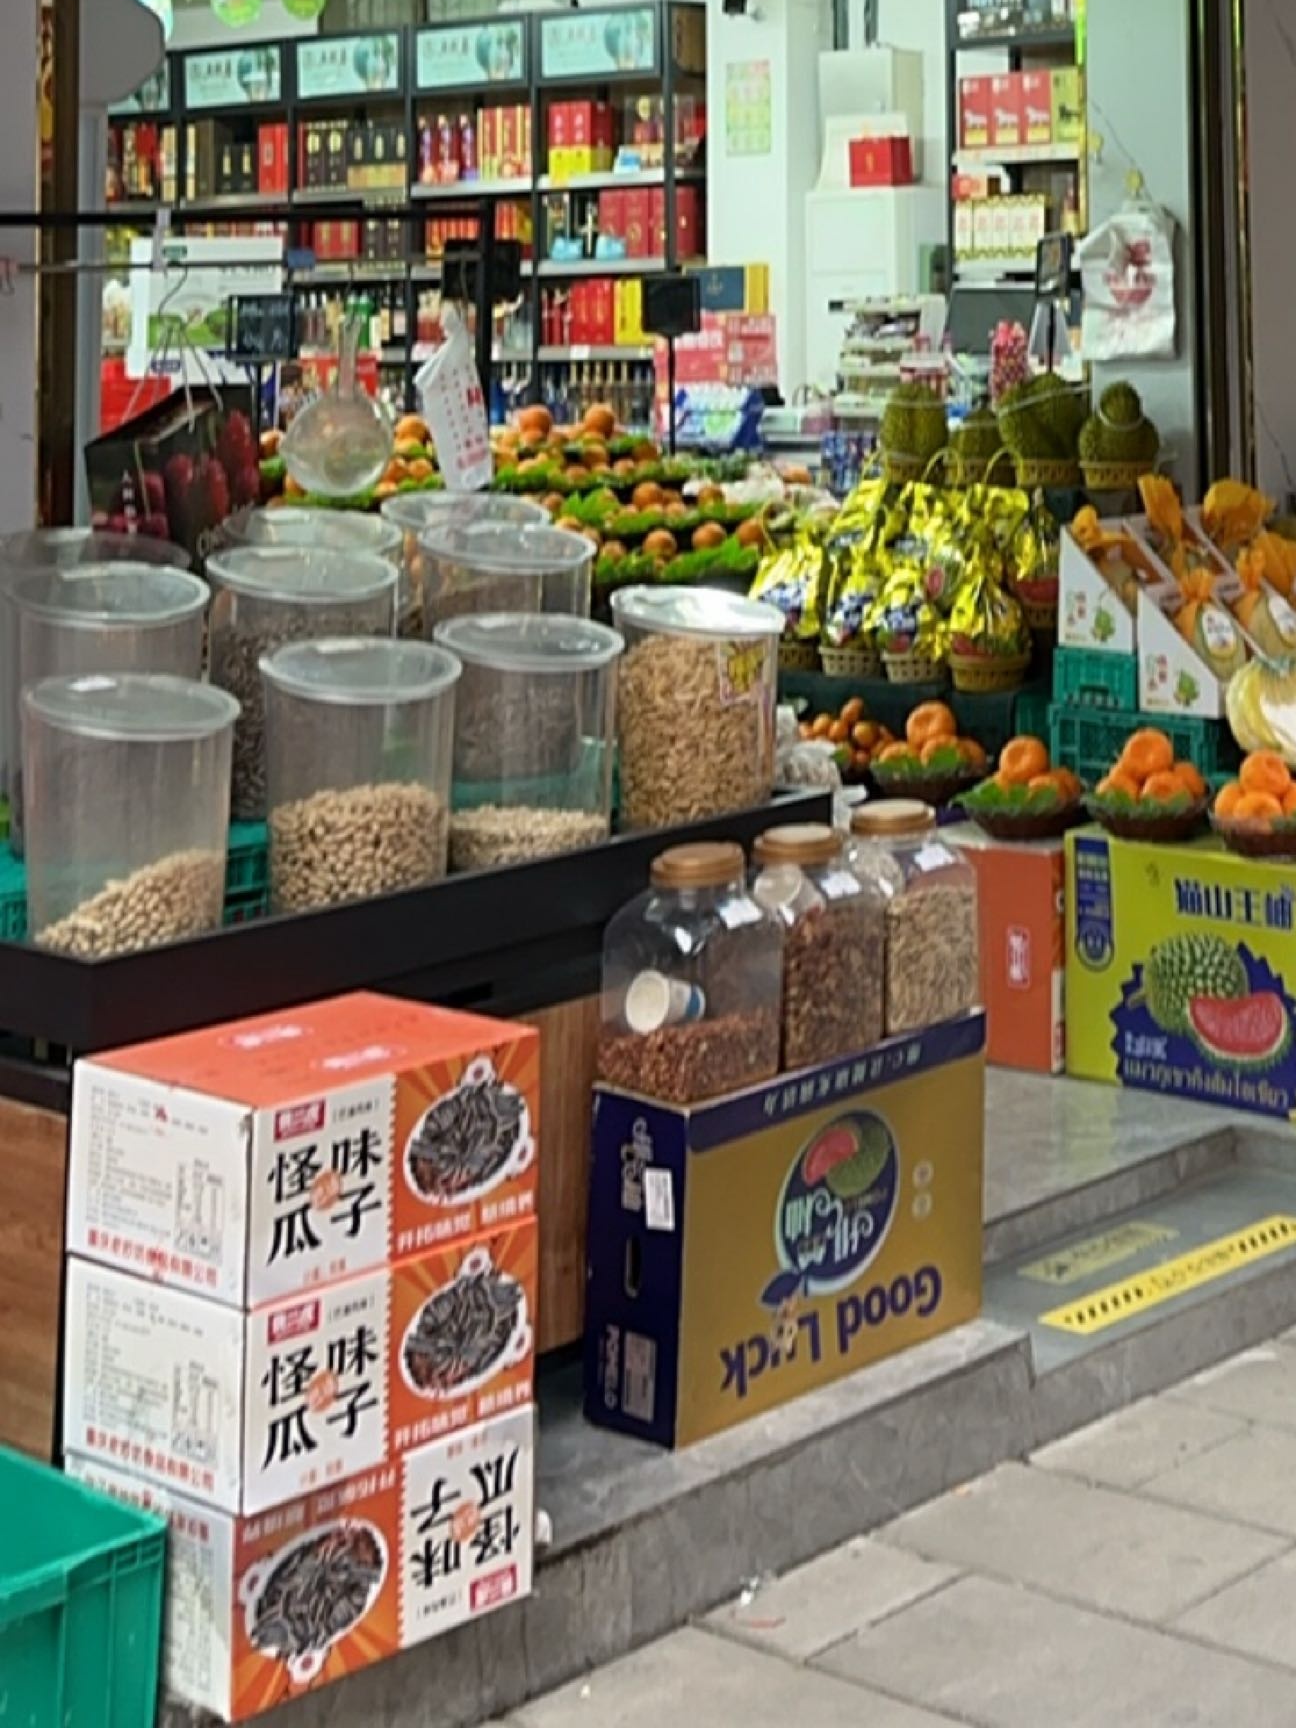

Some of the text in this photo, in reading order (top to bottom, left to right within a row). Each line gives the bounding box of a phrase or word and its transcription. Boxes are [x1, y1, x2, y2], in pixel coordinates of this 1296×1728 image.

[267, 1128, 382, 1204] 怪味
[266, 1183, 383, 1268] 瓜子
[836, 1264, 943, 1354] Good
[261, 1325, 377, 1408] 怪味
[262, 1381, 378, 1471] 瓜子
[410, 1444, 519, 1535] 瓜子
[410, 1504, 520, 1589] 怪味
